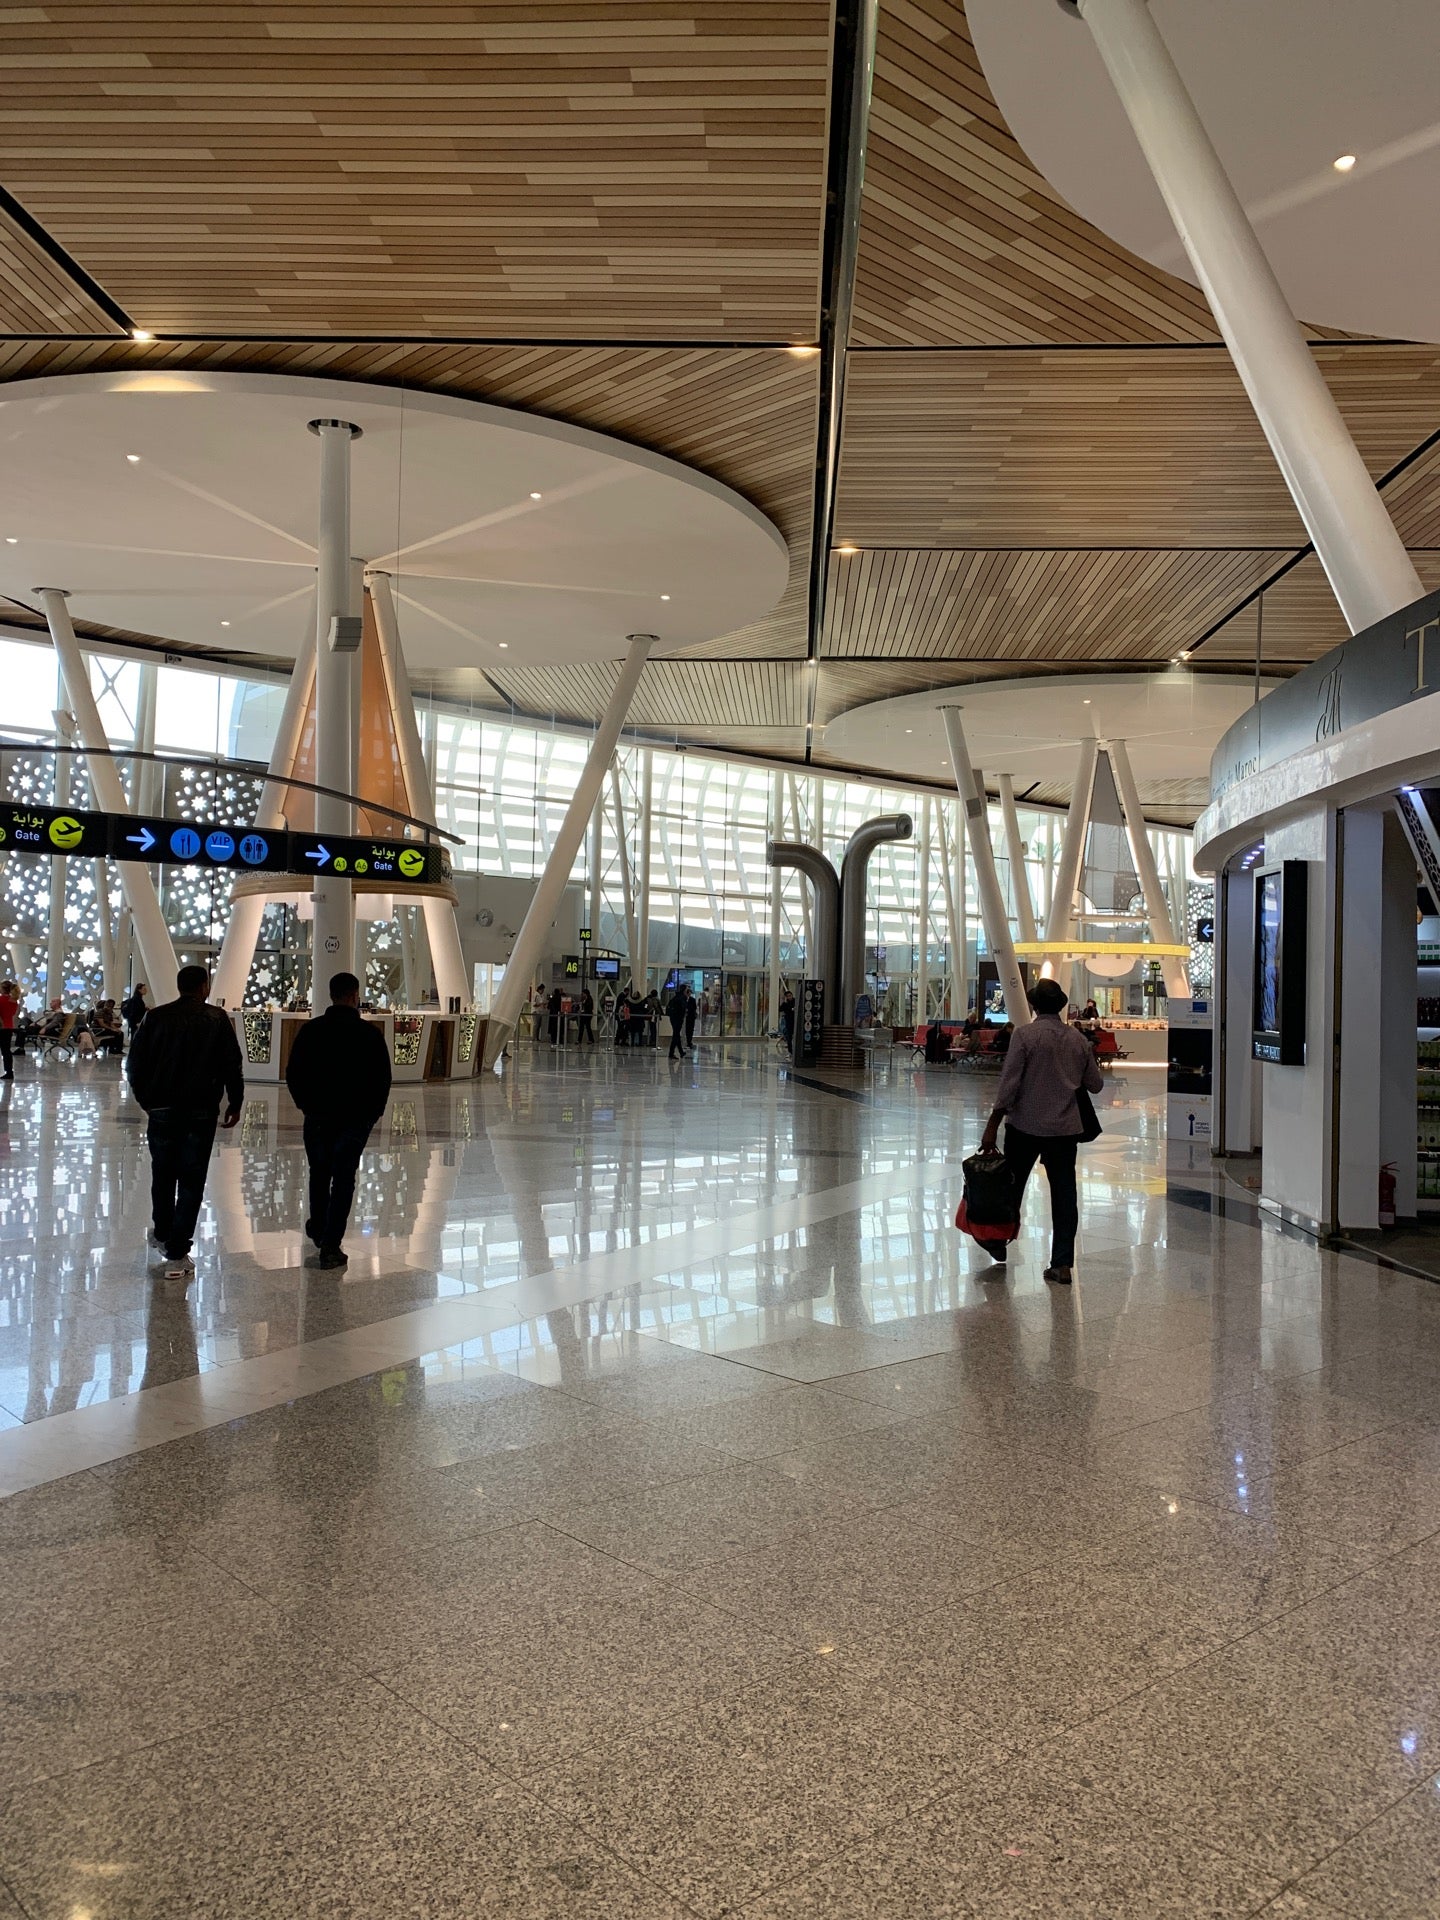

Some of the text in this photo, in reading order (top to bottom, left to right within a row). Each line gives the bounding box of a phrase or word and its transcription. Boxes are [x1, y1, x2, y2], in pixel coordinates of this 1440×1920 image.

[1235, 757, 1257, 782] Maroc
[12, 811, 44, 828] بوابة
[15, 829, 40, 841] Gate
[211, 835, 230, 845] VIP
[372, 845, 395, 859] بوابة
[335, 860, 346, 869] A1
[356, 861, 367, 870] A6
[374, 861, 392, 871] Gate
[581, 931, 590, 939] A6
[566, 962, 577, 973] A6
